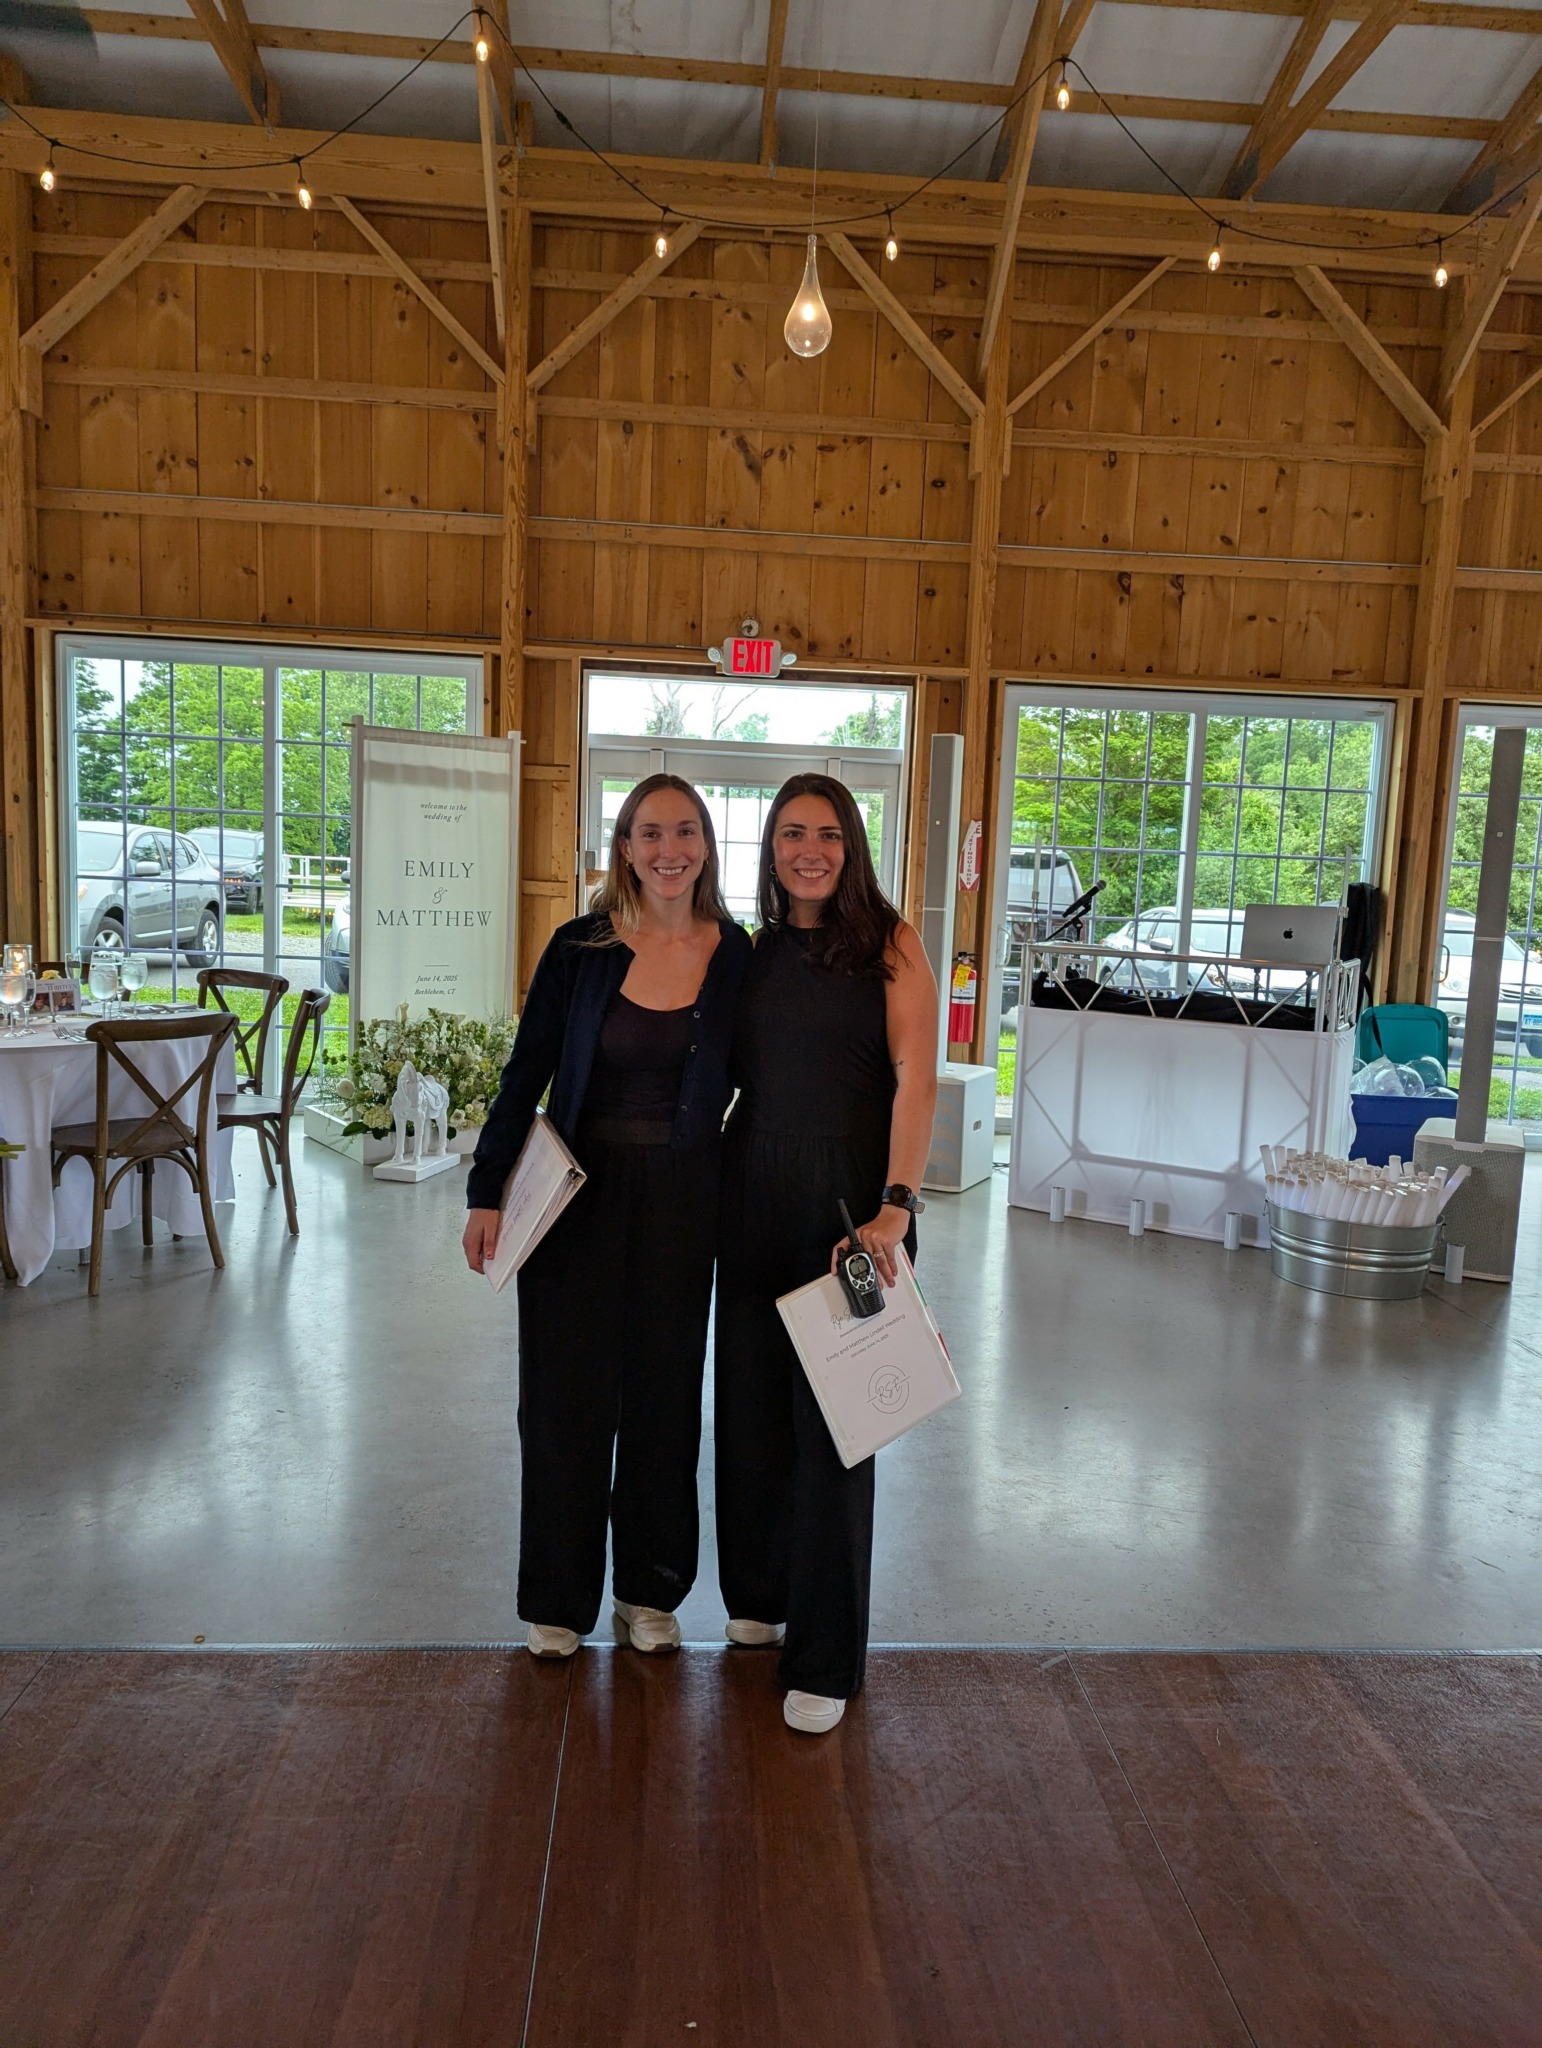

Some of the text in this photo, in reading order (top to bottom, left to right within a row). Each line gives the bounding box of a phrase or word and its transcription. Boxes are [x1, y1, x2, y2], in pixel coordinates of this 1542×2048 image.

[732, 639, 775, 674] EXIT
[420, 802, 448, 810] welcome
[423, 812, 463, 823] wedding of
[404, 860, 475, 879] EMILY
[431, 886, 448, 905] &
[376, 909, 492, 927] MATTHEW
[415, 975, 431, 983] June
[442, 974, 458, 982] 2025
[825, 1352, 840, 1363] Emily
[840, 1346, 849, 1355] and
[848, 1335, 870, 1350] Matthew
[884, 1314, 906, 1328] Wedding
